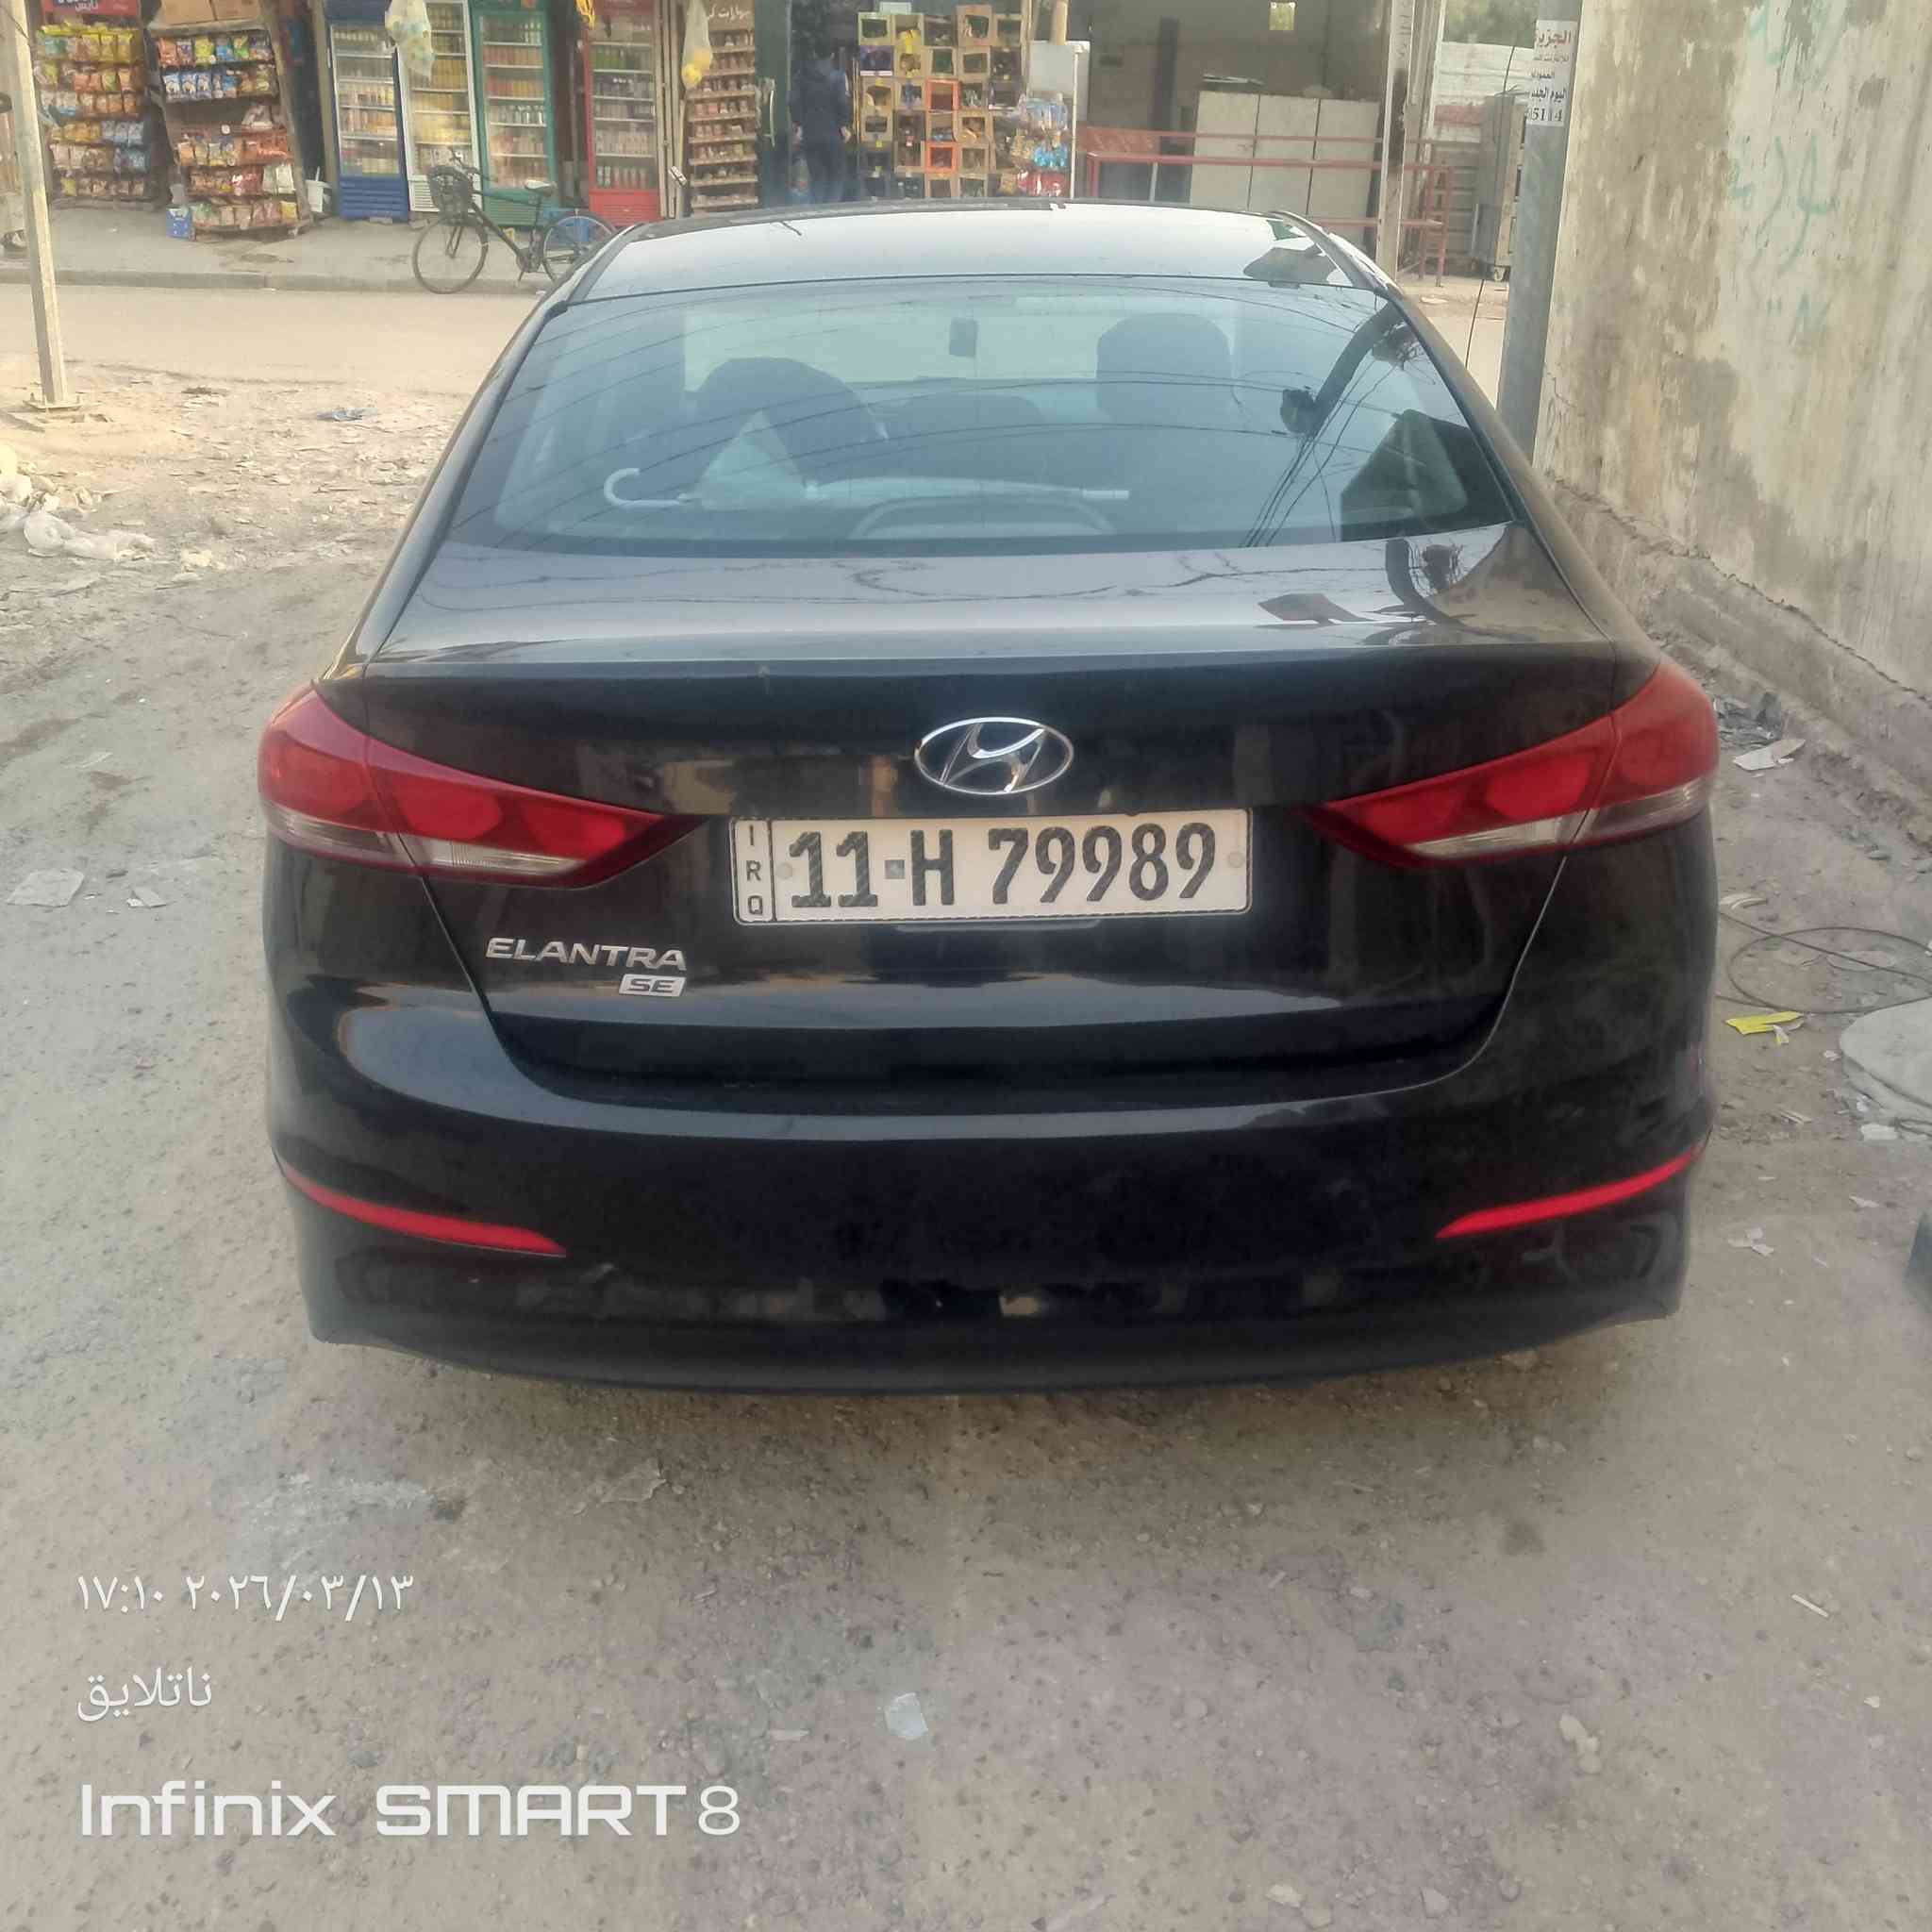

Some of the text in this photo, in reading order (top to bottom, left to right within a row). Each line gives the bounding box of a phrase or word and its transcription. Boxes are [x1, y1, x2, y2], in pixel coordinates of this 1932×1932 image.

[988, 822, 1217, 904] 79989
[485, 937, 688, 972] ELANTRA
[627, 977, 677, 995] SE
